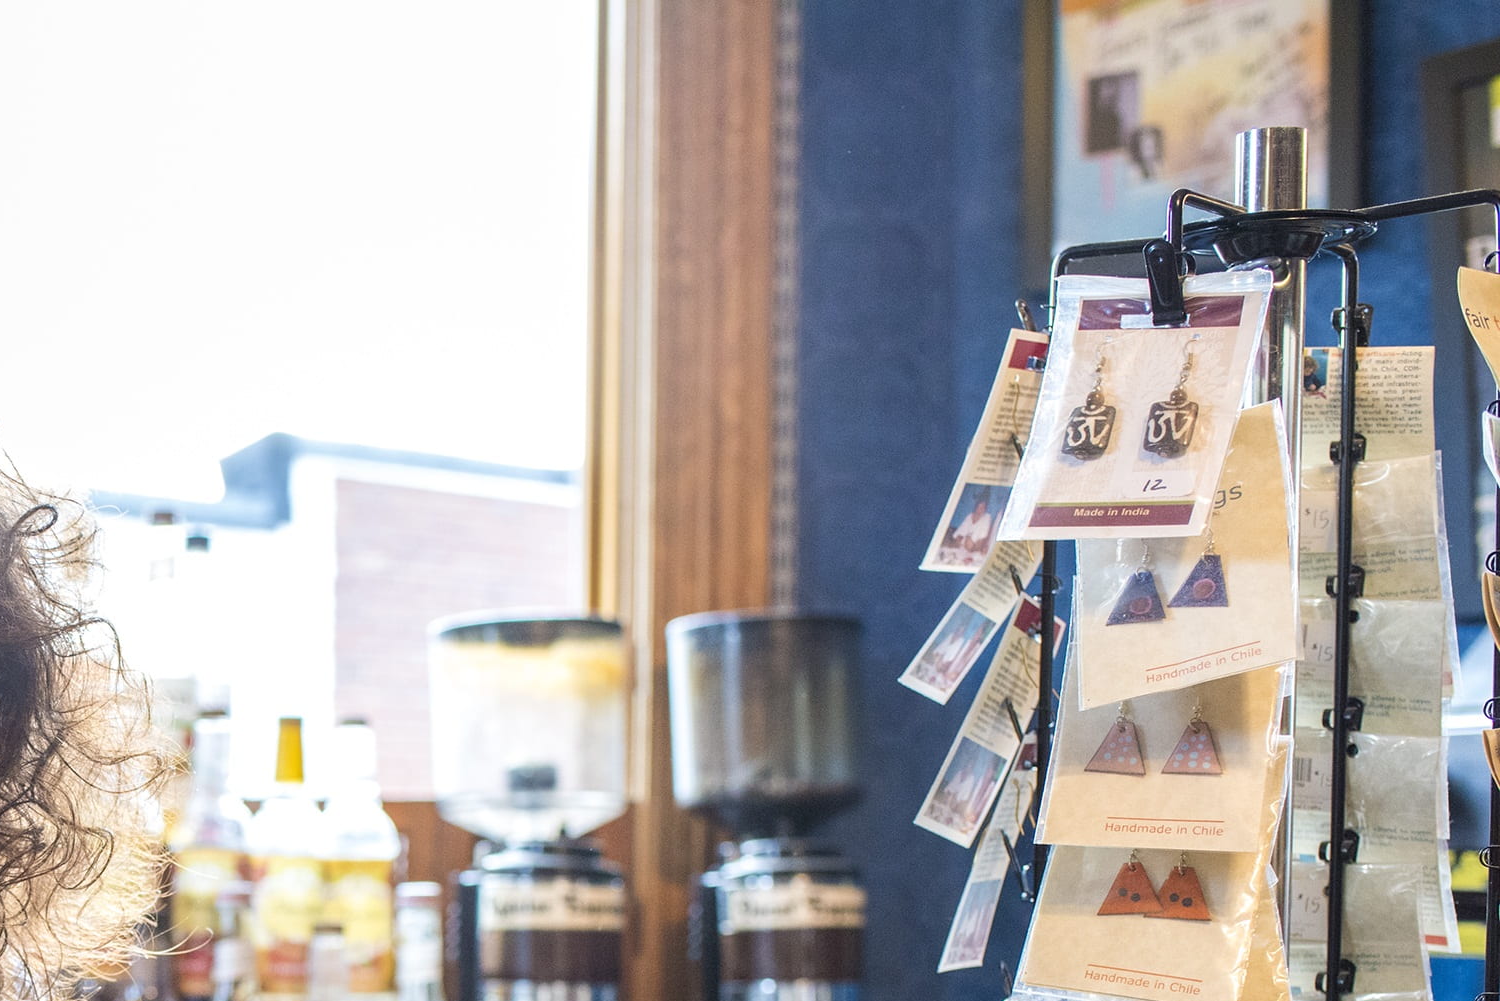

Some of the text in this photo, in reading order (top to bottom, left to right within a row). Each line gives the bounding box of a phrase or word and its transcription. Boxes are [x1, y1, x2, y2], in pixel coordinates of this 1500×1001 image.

[1143, 479, 1167, 492] 12
[1074, 507, 1150, 517] Made in India
[1145, 646, 1262, 684] Handmade in Chile
[1104, 822, 1224, 836] Handmade in Chile
[1084, 970, 1201, 995] Handmade in Chile
